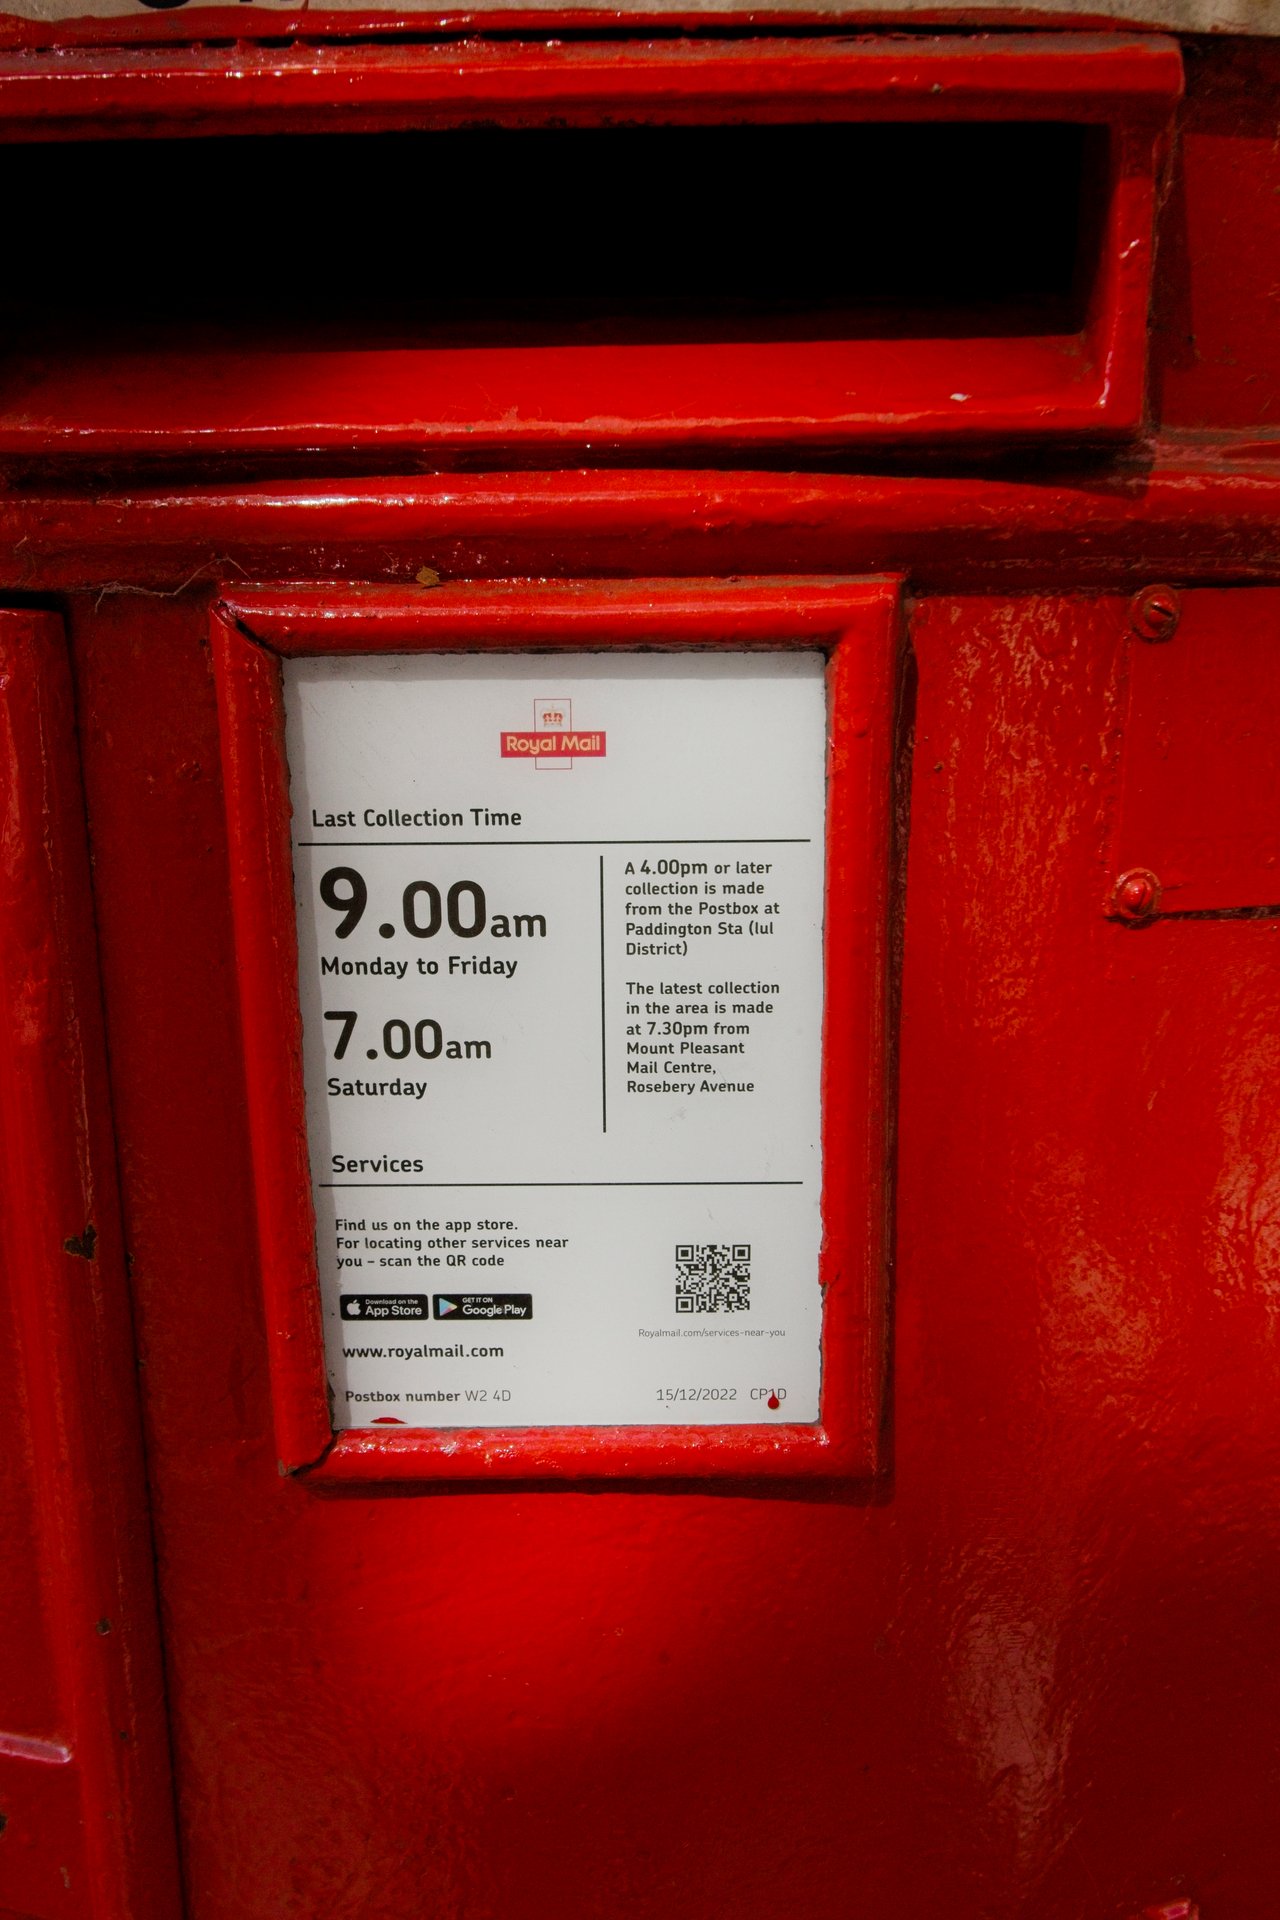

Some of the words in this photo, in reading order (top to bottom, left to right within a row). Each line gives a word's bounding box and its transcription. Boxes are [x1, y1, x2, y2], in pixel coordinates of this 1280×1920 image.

[506, 735, 556, 755] Royal
[560, 734, 602, 752] Mail
[311, 808, 357, 828] Last
[363, 808, 464, 828] Collection
[469, 807, 522, 827] Time
[624, 861, 636, 876] A
[639, 858, 708, 879] 4.00pm
[713, 864, 731, 875] or
[736, 860, 773, 875] later
[625, 881, 698, 896] collection
[704, 881, 717, 895] is
[722, 881, 765, 895] made
[319, 866, 547, 941] 9.00am
[624, 902, 662, 916] from
[667, 901, 693, 916] the
[698, 901, 759, 915] Postbox
[763, 902, 781, 915] at
[625, 921, 712, 939] Paddington
[717, 921, 744, 935] Sta
[626, 940, 688, 957] District)
[320, 955, 409, 980] Monday
[415, 957, 439, 976] to
[448, 955, 518, 979] Friday
[625, 981, 655, 995] The
[660, 981, 703, 995] latest
[707, 980, 780, 995] collection
[626, 1001, 640, 1015] in
[644, 1001, 670, 1015] the
[675, 1004, 709, 1015] area
[714, 1000, 727, 1014] is
[731, 1000, 774, 1014] made
[324, 1010, 492, 1061] 7.00am
[626, 1023, 642, 1036] at
[646, 1021, 708, 1039] 7.30pm
[713, 1021, 750, 1035] from
[626, 1041, 675, 1055] Mount
[680, 1041, 745, 1055] Pleasant
[626, 1060, 658, 1074] Mail
[663, 1060, 717, 1075] Centre,
[327, 1077, 428, 1100] Saturday
[627, 1080, 696, 1096] Rosebery
[699, 1079, 755, 1093] Avenue
[331, 1154, 424, 1174] Services
[334, 1218, 367, 1232] Find
[371, 1221, 389, 1231] us
[393, 1221, 411, 1231] on
[415, 1218, 440, 1231] the
[445, 1221, 472, 1233] app
[476, 1219, 518, 1231] store.
[335, 1236, 361, 1250] For
[364, 1236, 422, 1252] locating
[427, 1236, 467, 1249] other
[471, 1236, 531, 1249] services
[535, 1238, 569, 1248] near
[335, 1257, 363, 1271] you
[379, 1257, 412, 1267] scan
[416, 1254, 441, 1267] the
[446, 1254, 467, 1267] QR
[471, 1254, 505, 1267] code
[365, 1305, 389, 1317] App
[391, 1305, 422, 1316] Store
[462, 1304, 502, 1317] Google
[504, 1304, 527, 1316] Play
[638, 1327, 786, 1339] Royalmail.com/services-near-you
[341, 1343, 504, 1361] www.royalmail.com
[344, 1389, 401, 1403] Postbox
[405, 1390, 461, 1402] number
[464, 1389, 488, 1402] W2
[492, 1389, 511, 1402] 4D
[656, 1387, 737, 1402] 15/12/2022
